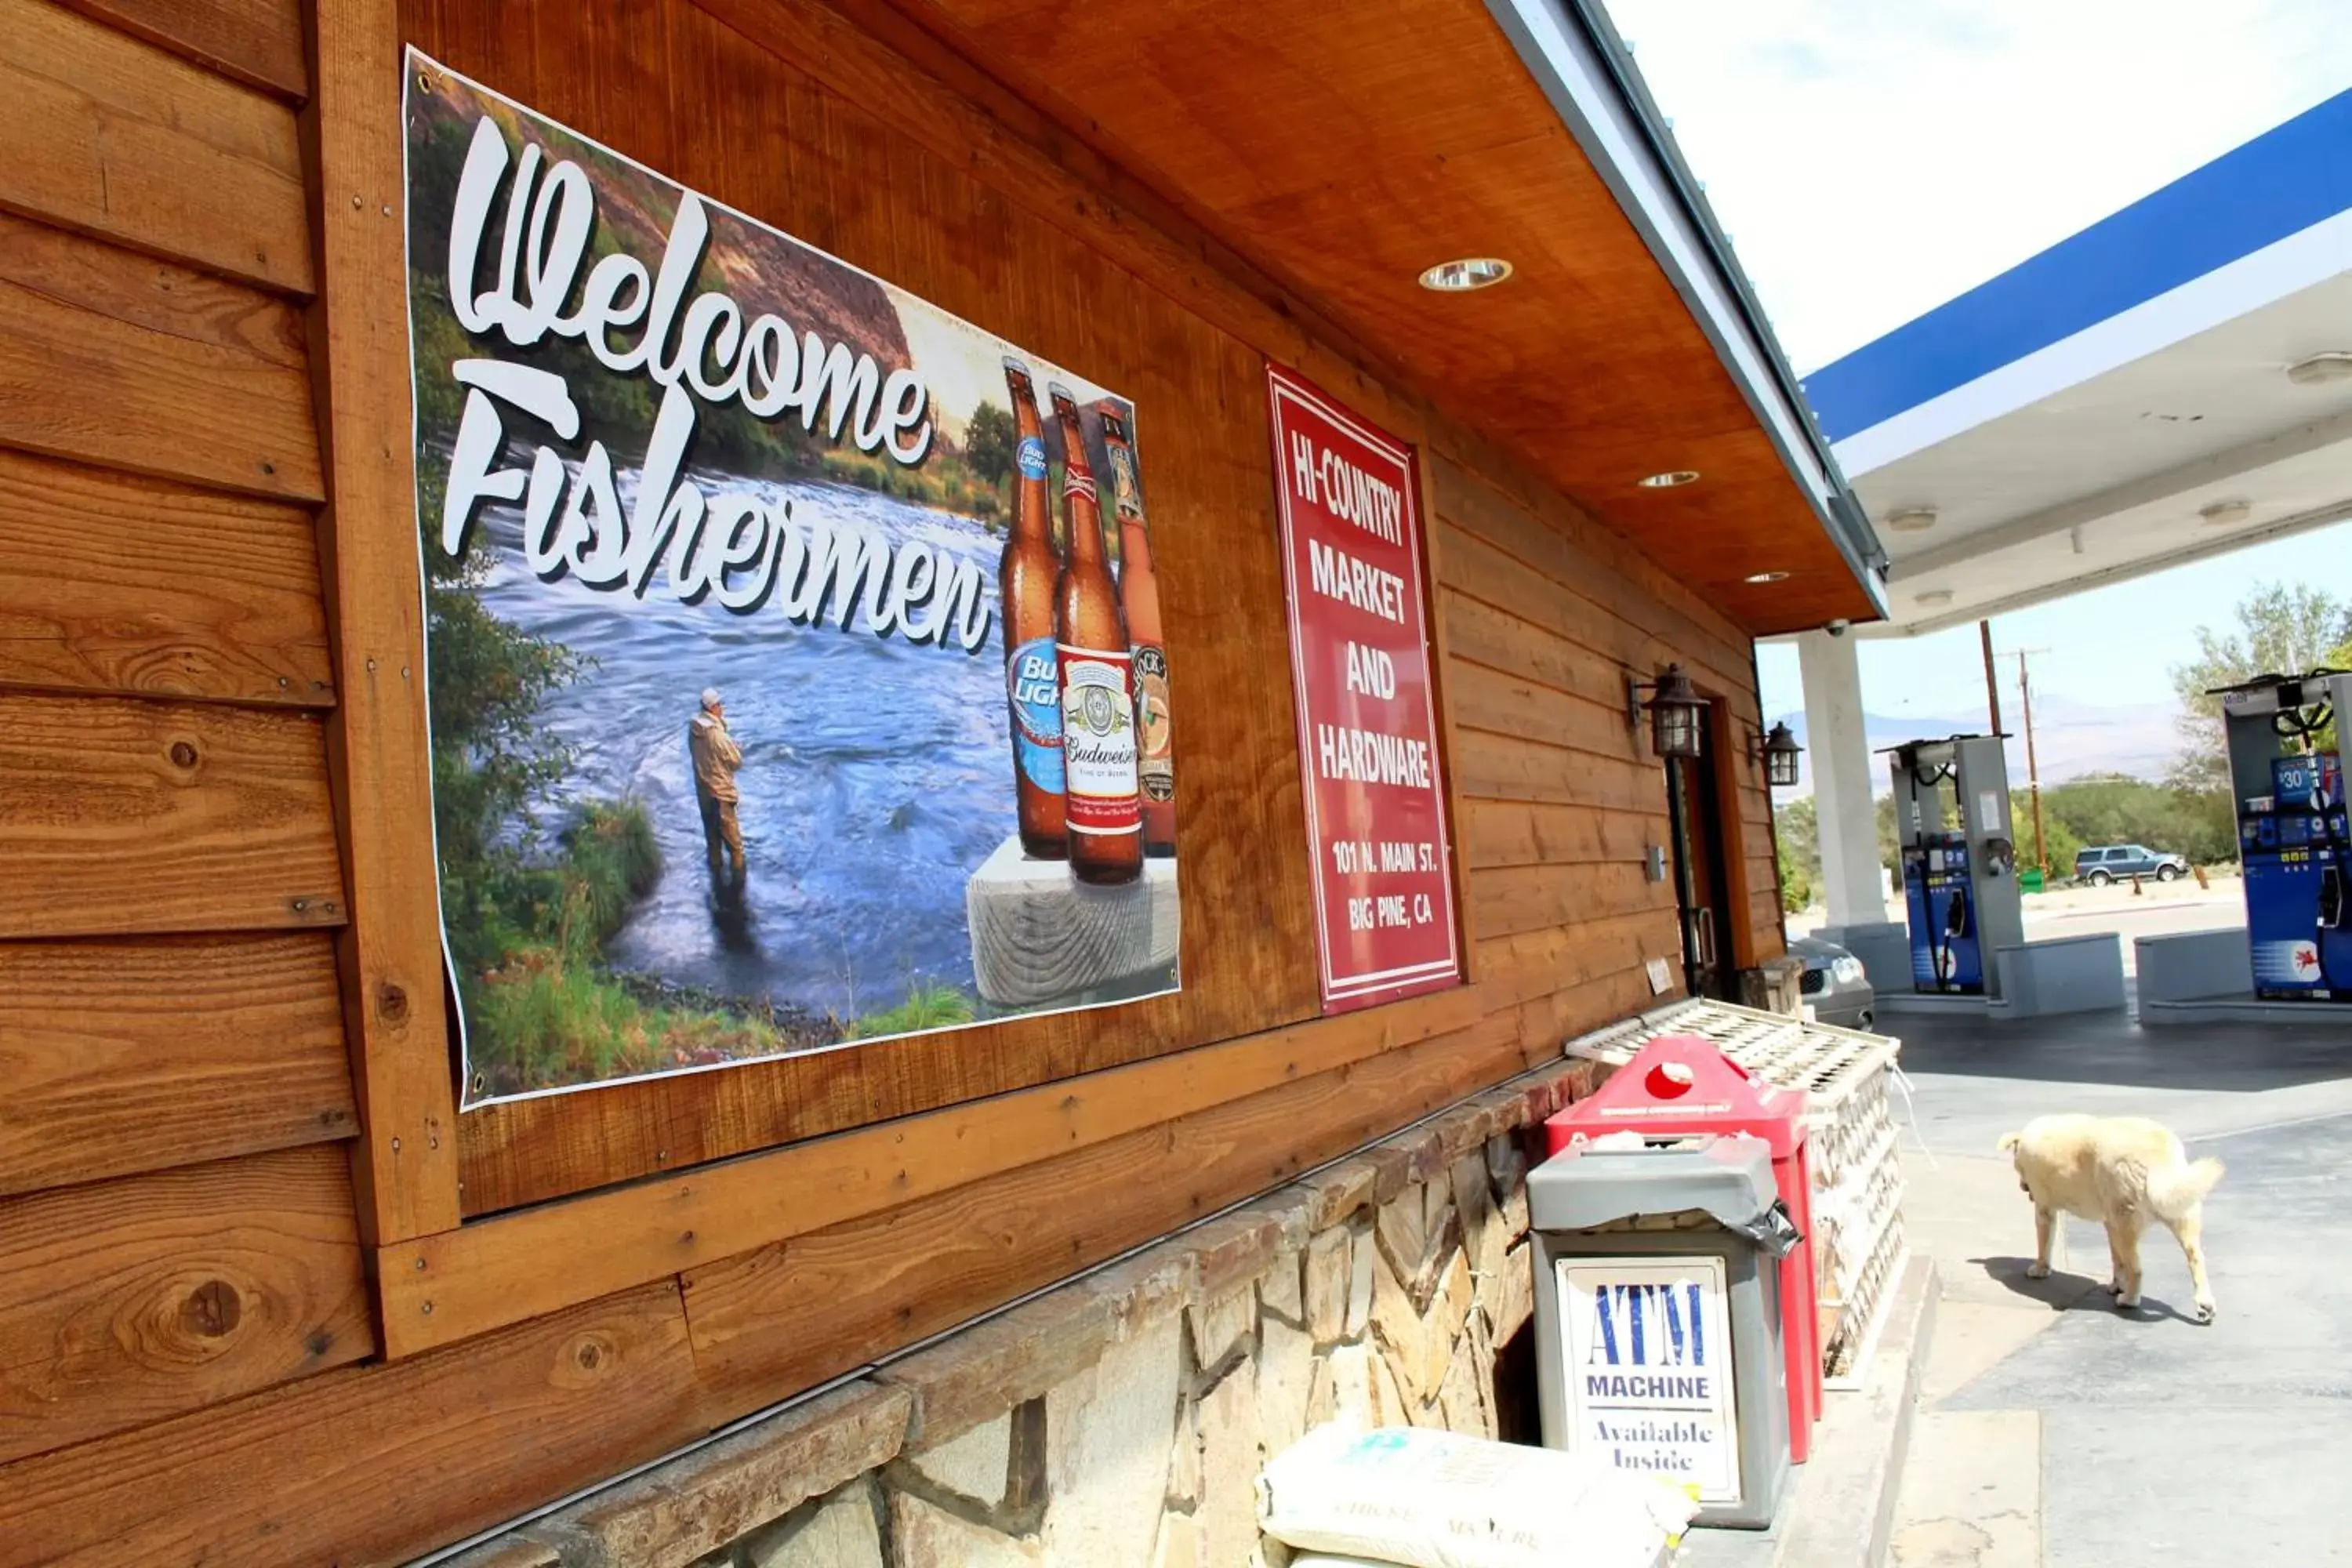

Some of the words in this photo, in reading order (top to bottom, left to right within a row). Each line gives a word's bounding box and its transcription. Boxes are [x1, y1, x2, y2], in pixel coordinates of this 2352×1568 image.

[448, 115, 931, 465] Welcome
[1023, 444, 1045, 461] BUD
[442, 358, 990, 652] Fishermen
[1290, 429, 1403, 547] HI-COUNTRY
[1308, 538, 1405, 625] MARKET
[1022, 655, 1058, 682] BU
[1346, 640, 1395, 701] AND
[1015, 677, 1059, 706] LIGH
[1318, 724, 1431, 789] HARDWARE
[1332, 841, 1358, 874] 101
[1361, 841, 1377, 873] N.
[1380, 841, 1417, 873] MAIN
[1419, 842, 1438, 873] ST.
[1348, 896, 1374, 931] BIG
[1377, 895, 1411, 929] PINE,
[1414, 893, 1434, 924] CA
[1585, 1284, 1706, 1367] ATM
[1586, 1374, 1711, 1399] MACHINE
[1594, 1420, 1713, 1443] Available
[1613, 1448, 1693, 1471] Inside
